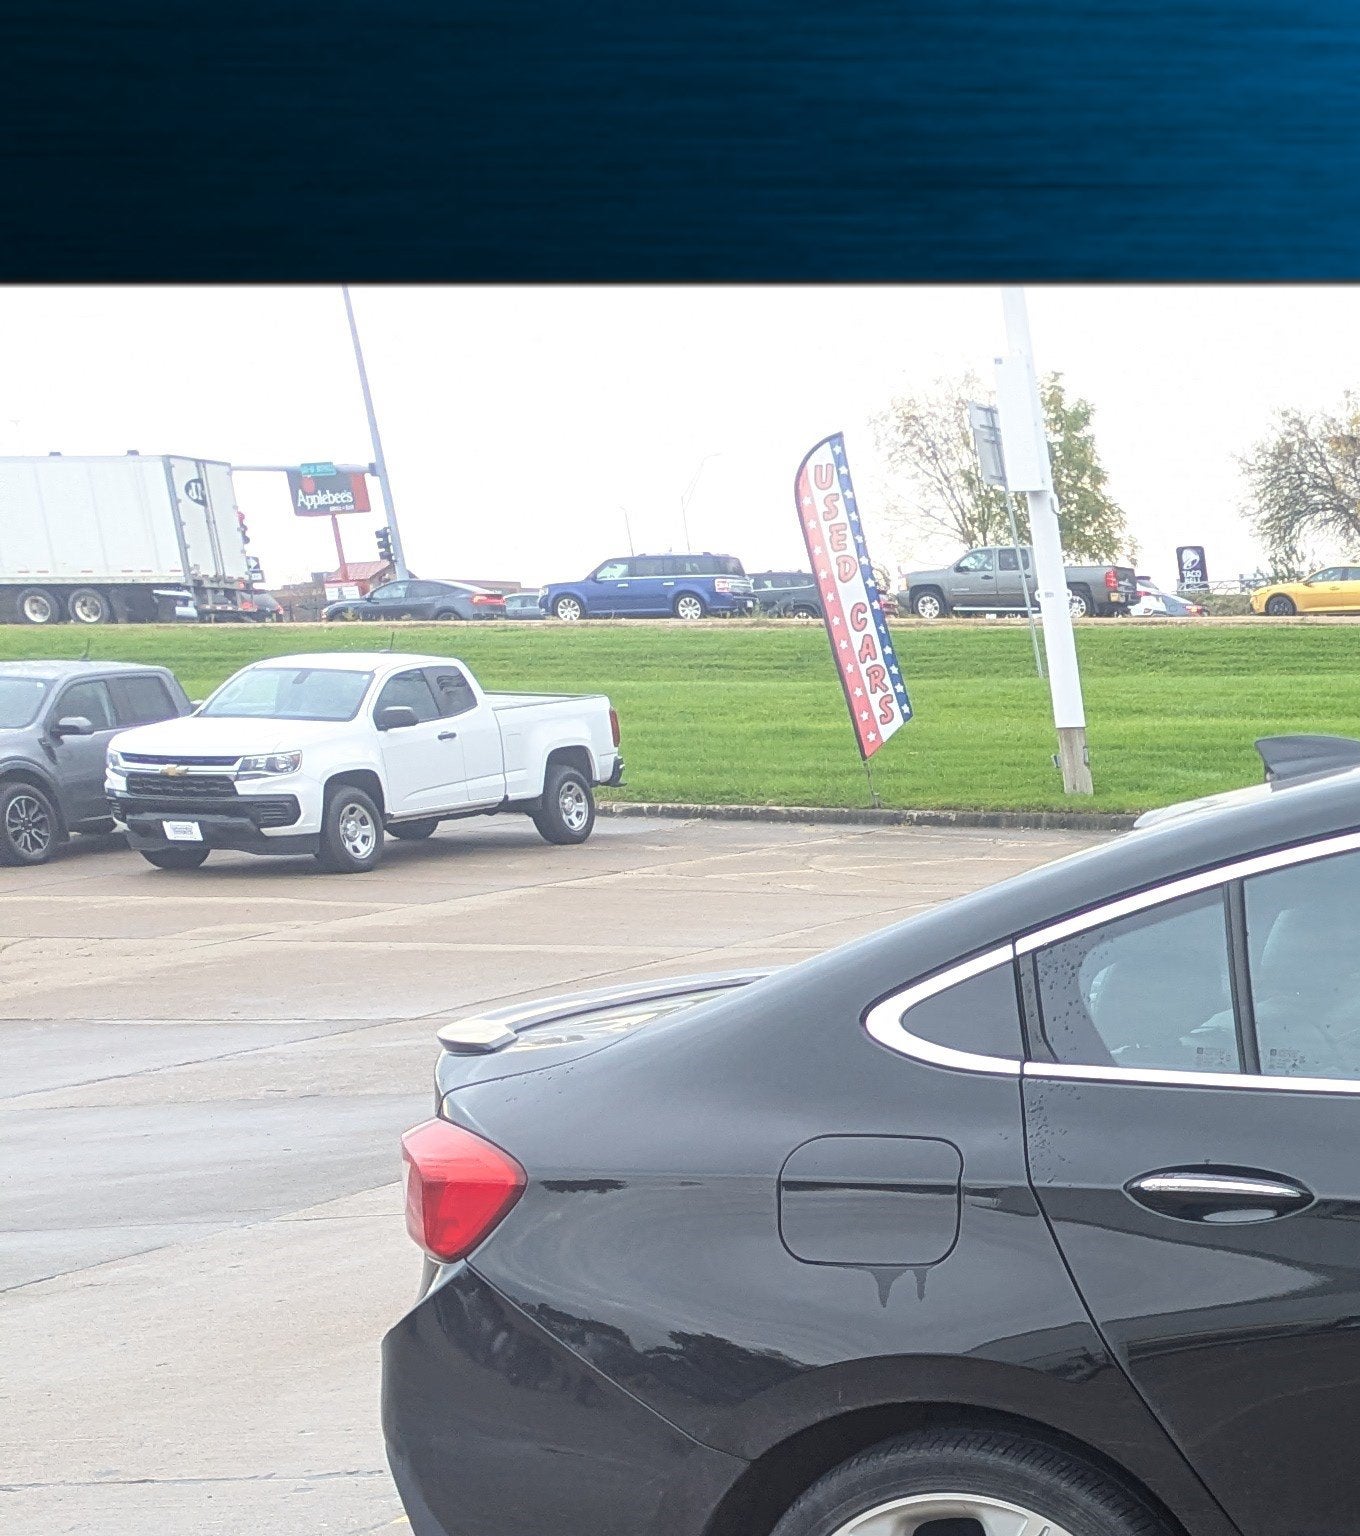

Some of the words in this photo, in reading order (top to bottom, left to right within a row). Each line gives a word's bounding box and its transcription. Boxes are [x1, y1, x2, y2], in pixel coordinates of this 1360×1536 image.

[814, 463, 857, 583] USED
[850, 602, 894, 725] CARS
[1182, 570, 1202, 578] TACO
